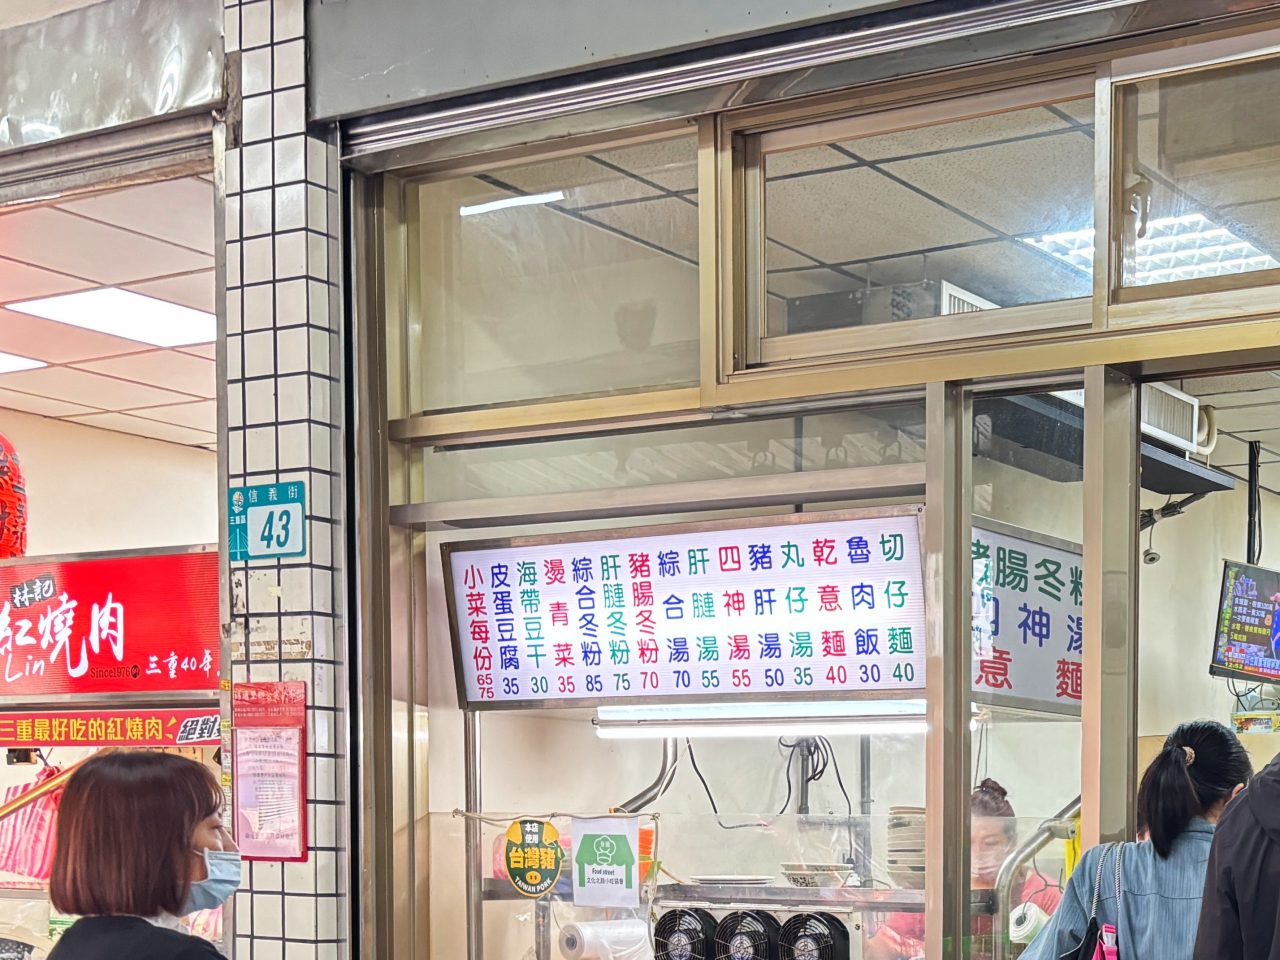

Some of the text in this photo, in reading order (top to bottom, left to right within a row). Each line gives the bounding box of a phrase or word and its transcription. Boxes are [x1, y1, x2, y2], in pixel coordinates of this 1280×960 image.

[249, 485, 298, 503] 信義街
[260, 510, 291, 548] 43
[0, 592, 125, 678] 紅燒肉
[12, 579, 54, 607] 林記
[464, 564, 495, 699] 小菜每份 65 75
[491, 562, 519, 695] 皮蛋豆腐 35
[517, 560, 548, 694] 海帶豆干 30
[544, 558, 575, 693] 燙青菜 35
[571, 556, 603, 692] 綜合冬粉 85
[628, 551, 659, 689] 豬腸冬粉 70
[657, 550, 691, 688] 綜合湯 70
[718, 545, 751, 687] 四神湯 55
[748, 542, 785, 687] 豬肝湯 50
[780, 540, 814, 686] 丸仔湯 35
[812, 537, 847, 684] 乾意麵 40
[846, 536, 881, 683] 魯肉飯 30
[879, 533, 915, 682] 切仔麵 40
[5, 655, 45, 682] Lin
[145, 649, 219, 679] 三重40年
[613, 673, 631, 691] 75
[702, 669, 720, 688] 55
[509, 847, 555, 869] 台灣豬
[514, 876, 552, 893] TAIWAN PORK
[525, 822, 539, 832] 本店
[525, 834, 539, 844] 使用
